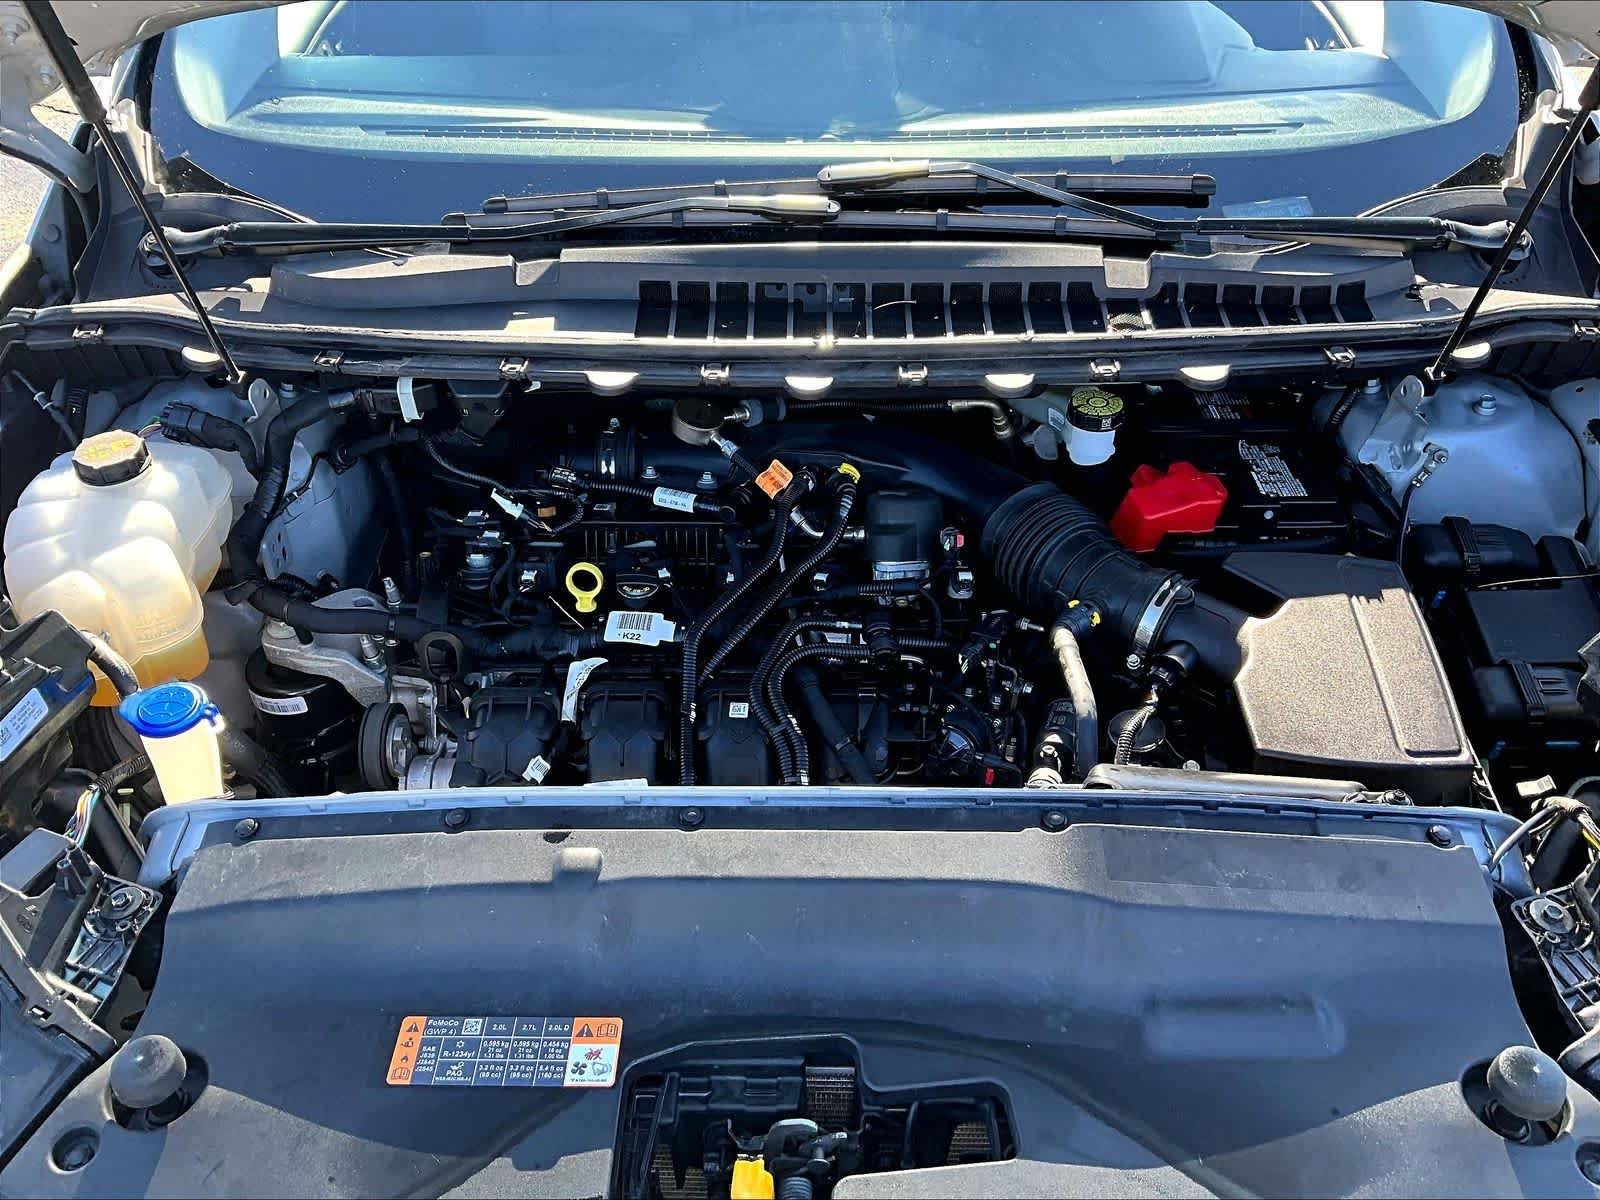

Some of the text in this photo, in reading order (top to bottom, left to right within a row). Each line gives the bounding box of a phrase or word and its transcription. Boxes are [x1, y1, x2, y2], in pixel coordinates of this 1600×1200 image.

[622, 632, 641, 640] K22
[448, 1028, 457, 1036] 4)
[501, 1040, 509, 1048] kg
[531, 1040, 540, 1048] kg
